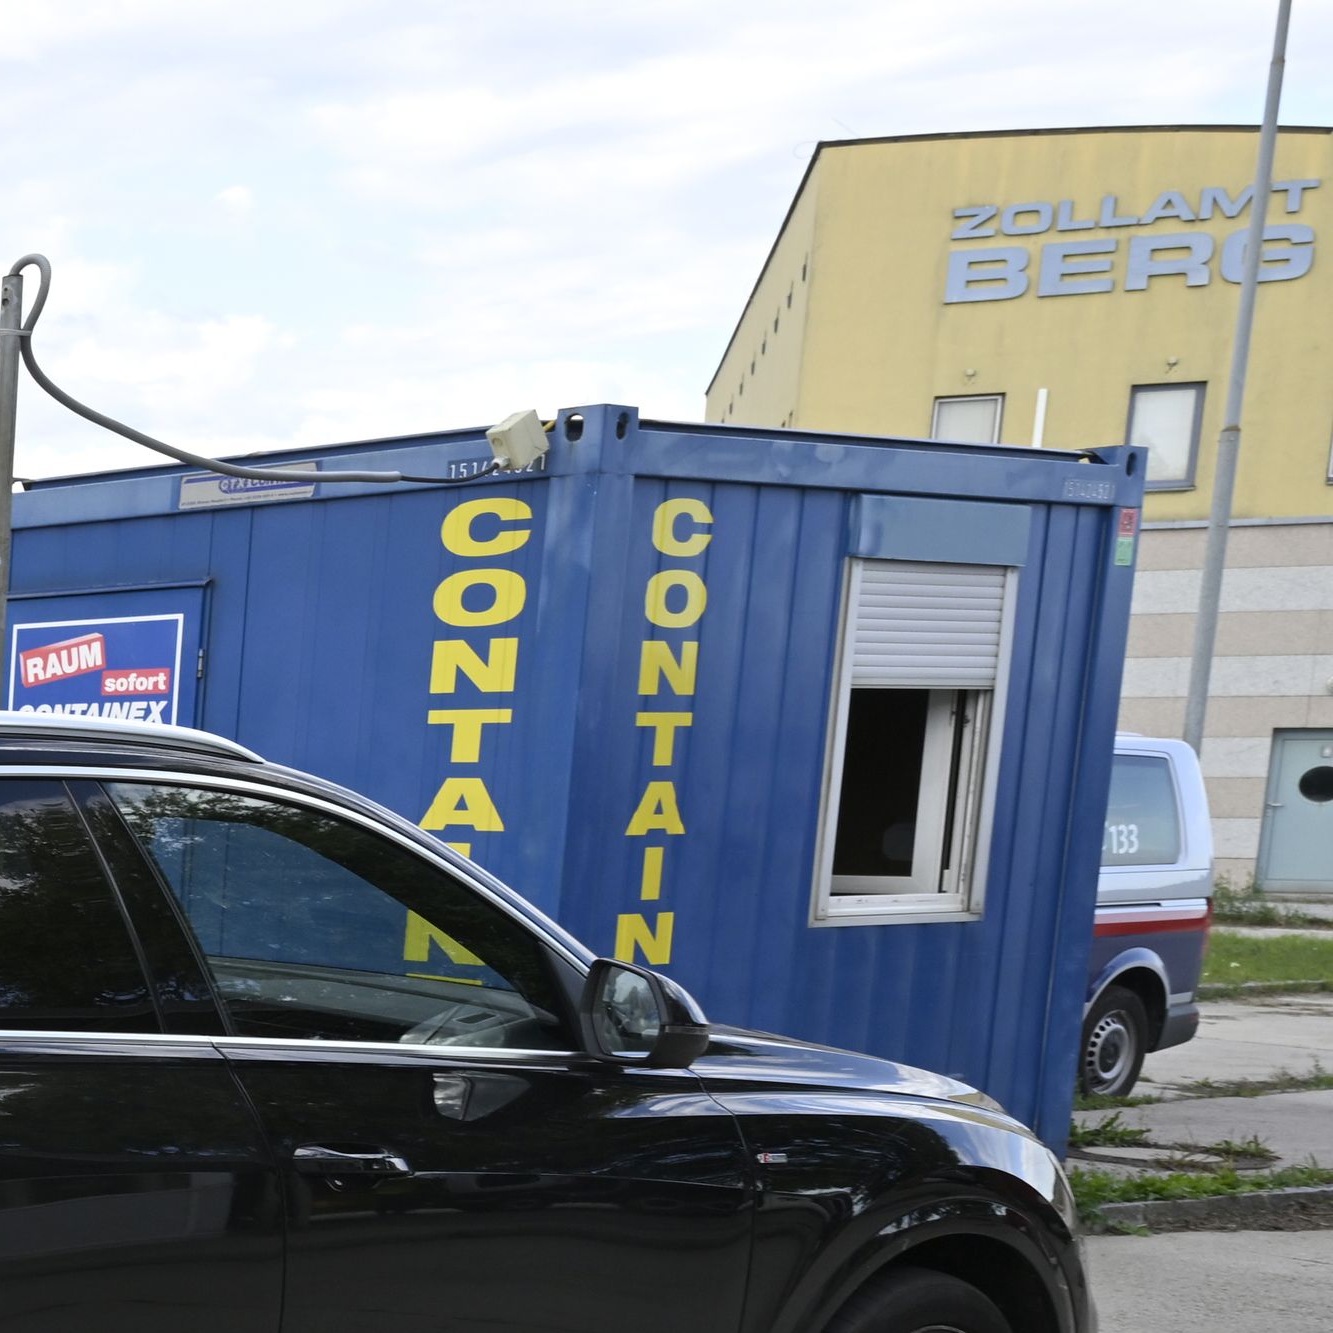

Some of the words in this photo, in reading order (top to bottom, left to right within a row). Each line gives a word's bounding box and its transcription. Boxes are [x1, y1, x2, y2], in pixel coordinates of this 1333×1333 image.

[950, 179, 1321, 240] ZOLLAMT
[944, 223, 1315, 305] BERG
[27, 641, 103, 683] RAUM
[104, 673, 167, 692] sofort
